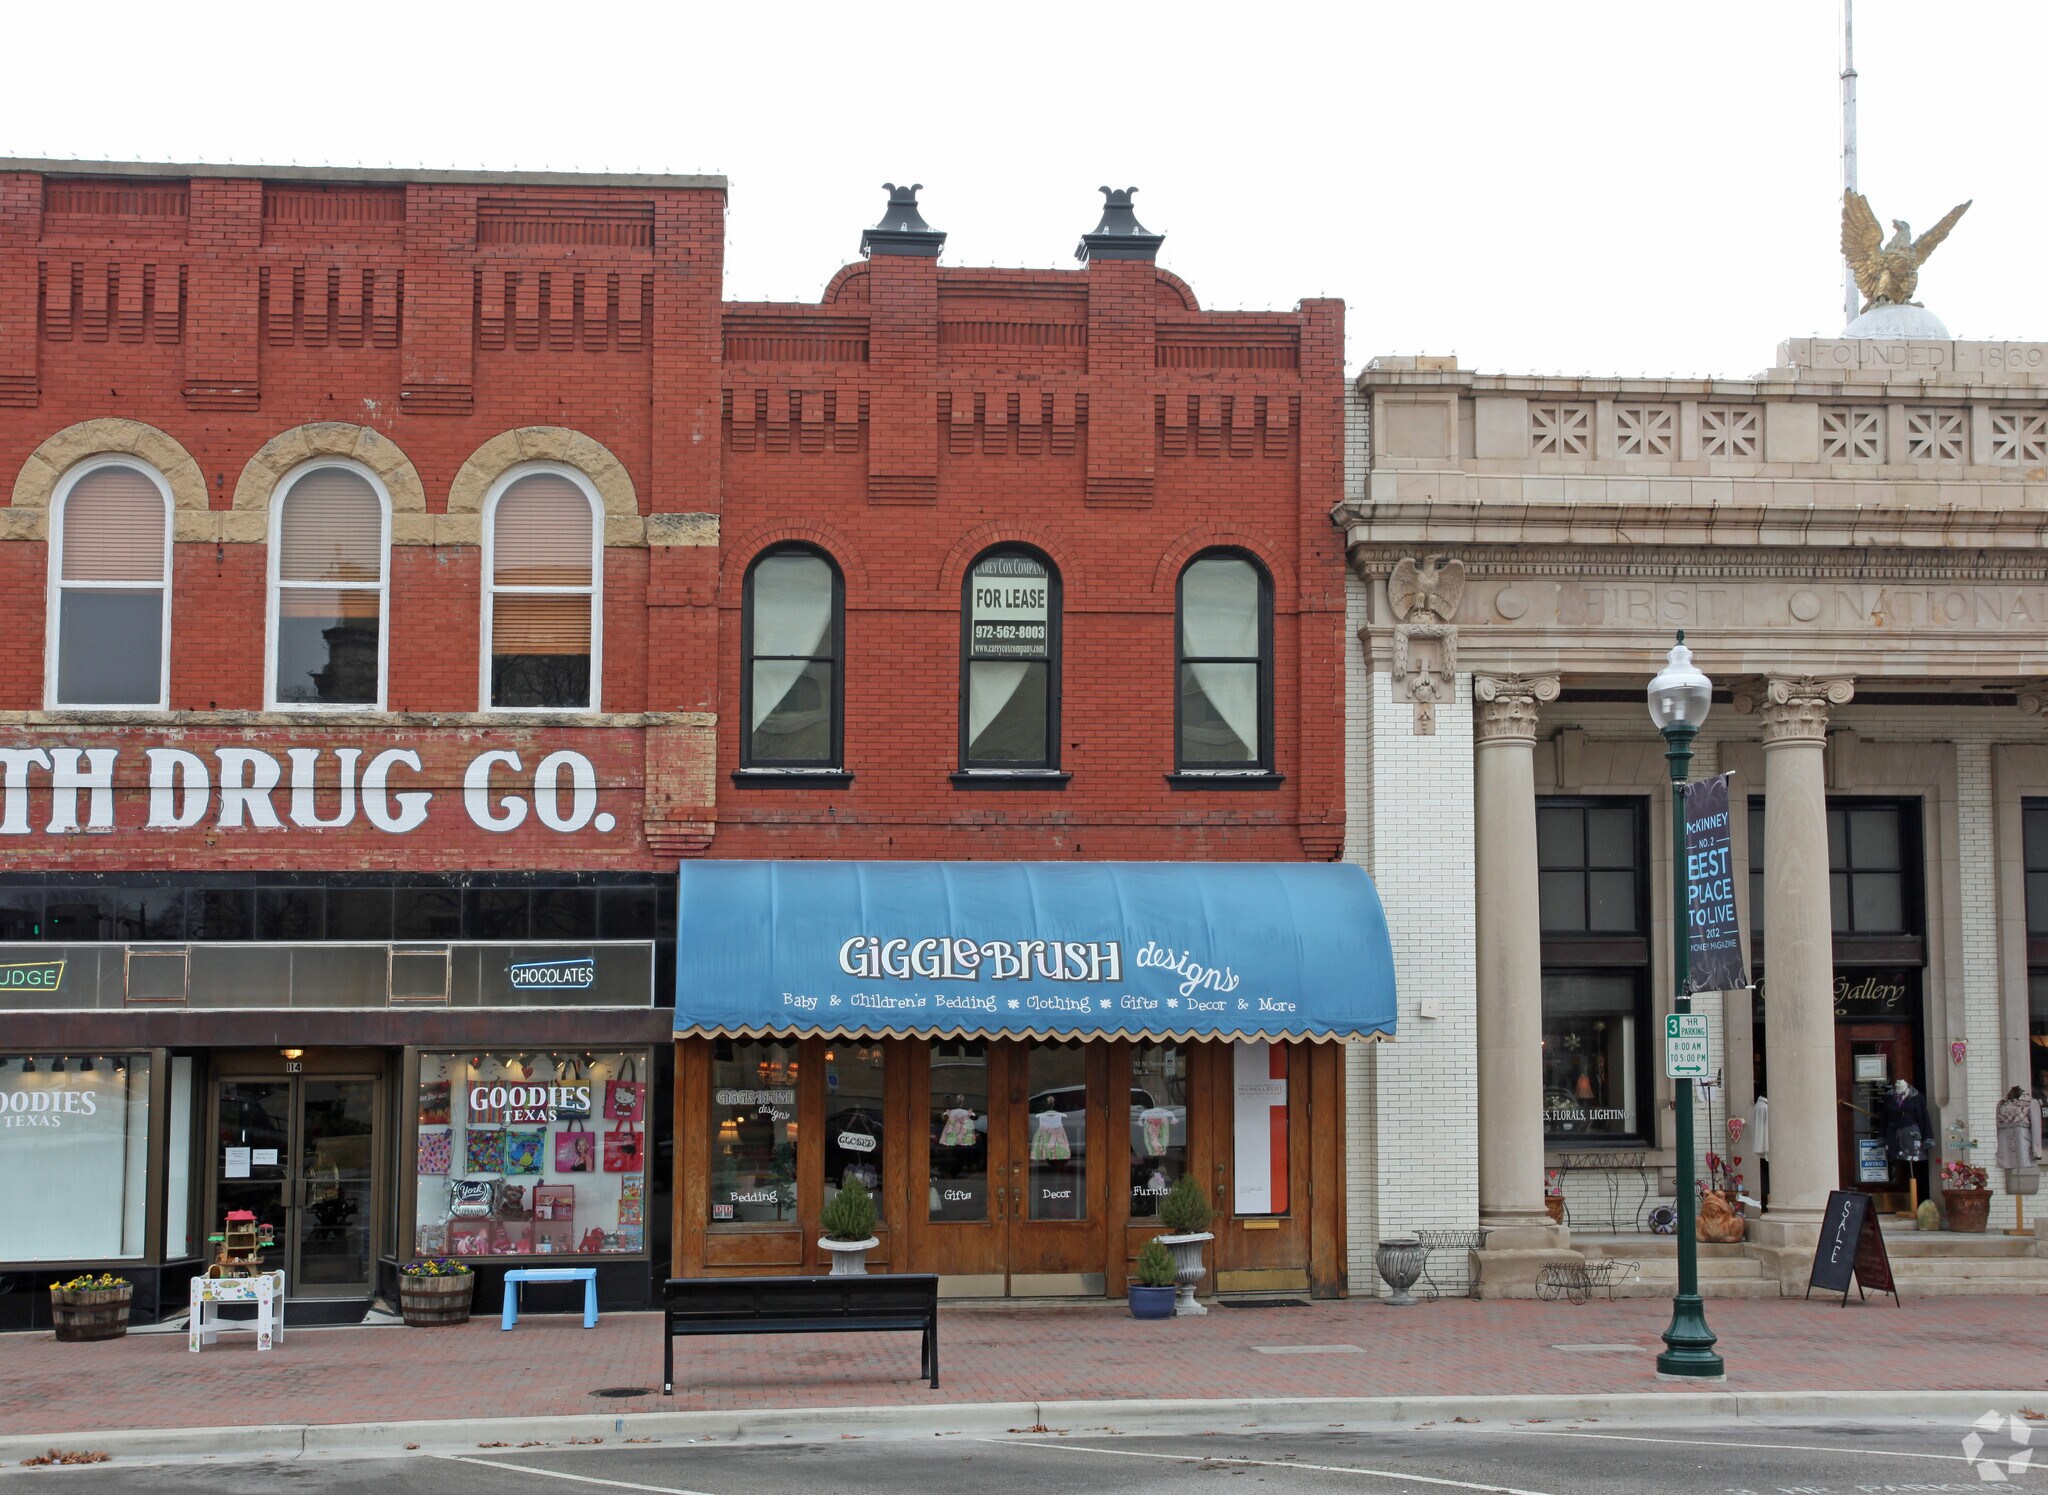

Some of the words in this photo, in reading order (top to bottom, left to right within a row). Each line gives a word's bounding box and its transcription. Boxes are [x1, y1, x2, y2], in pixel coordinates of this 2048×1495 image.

[1814, 344, 1945, 367] FOUNDED
[1978, 347, 2043, 367] 1869
[999, 559, 1013, 575] COX
[977, 589, 1002, 608] FOR
[1006, 589, 1045, 608] LEASE
[1583, 588, 1727, 621] FIRST
[975, 626, 1045, 639] 972-562-8003
[145, 748, 433, 833] DRUG
[463, 750, 616, 832] CO.
[1711, 837, 1715, 846] 2
[1688, 847, 1729, 880] BEST
[1688, 878, 1733, 905] PLACE
[1689, 909, 1707, 926] TO
[1707, 904, 1735, 924] LIVE
[510, 967, 594, 983] CHOCOLATES
[1136, 941, 1240, 997] designs
[1832, 976, 1905, 1007] Gallery
[783, 992, 818, 1010] Baby
[829, 994, 841, 1006] &
[850, 993, 926, 1009] Children's
[935, 994, 996, 1012] Bedding
[1026, 995, 1091, 1013] Clothing
[1120, 995, 1158, 1010] Gifts
[1187, 998, 1227, 1011] Decor
[1237, 998, 1249, 1010] &
[1258, 998, 1296, 1012] More
[1668, 1019, 1678, 1035] 3
[1681, 1027, 1705, 1036] PARKING
[1674, 1042, 1689, 1051] 8:00
[1692, 1042, 1702, 1051] AM
[1670, 1054, 1678, 1062] TO
[1680, 1054, 1695, 1062] 5:00
[1696, 1054, 1706, 1062] PM
[287, 1063, 301, 1072] 114
[471, 1086, 591, 1111] GOODIES
[503, 1109, 557, 1122] TEXAS
[758, 1104, 790, 1121] designs
[1553, 1109, 1587, 1122] FLORALS,
[4, 1115, 61, 1128] TEXAS
[839, 1135, 874, 1148] CLOSED
[460, 1184, 485, 1199] York
[730, 1190, 778, 1203] Bedding
[944, 1189, 972, 1201] Gifts
[1042, 1189, 1072, 1199] Decor
[1830, 1200, 1851, 1263] SALE
